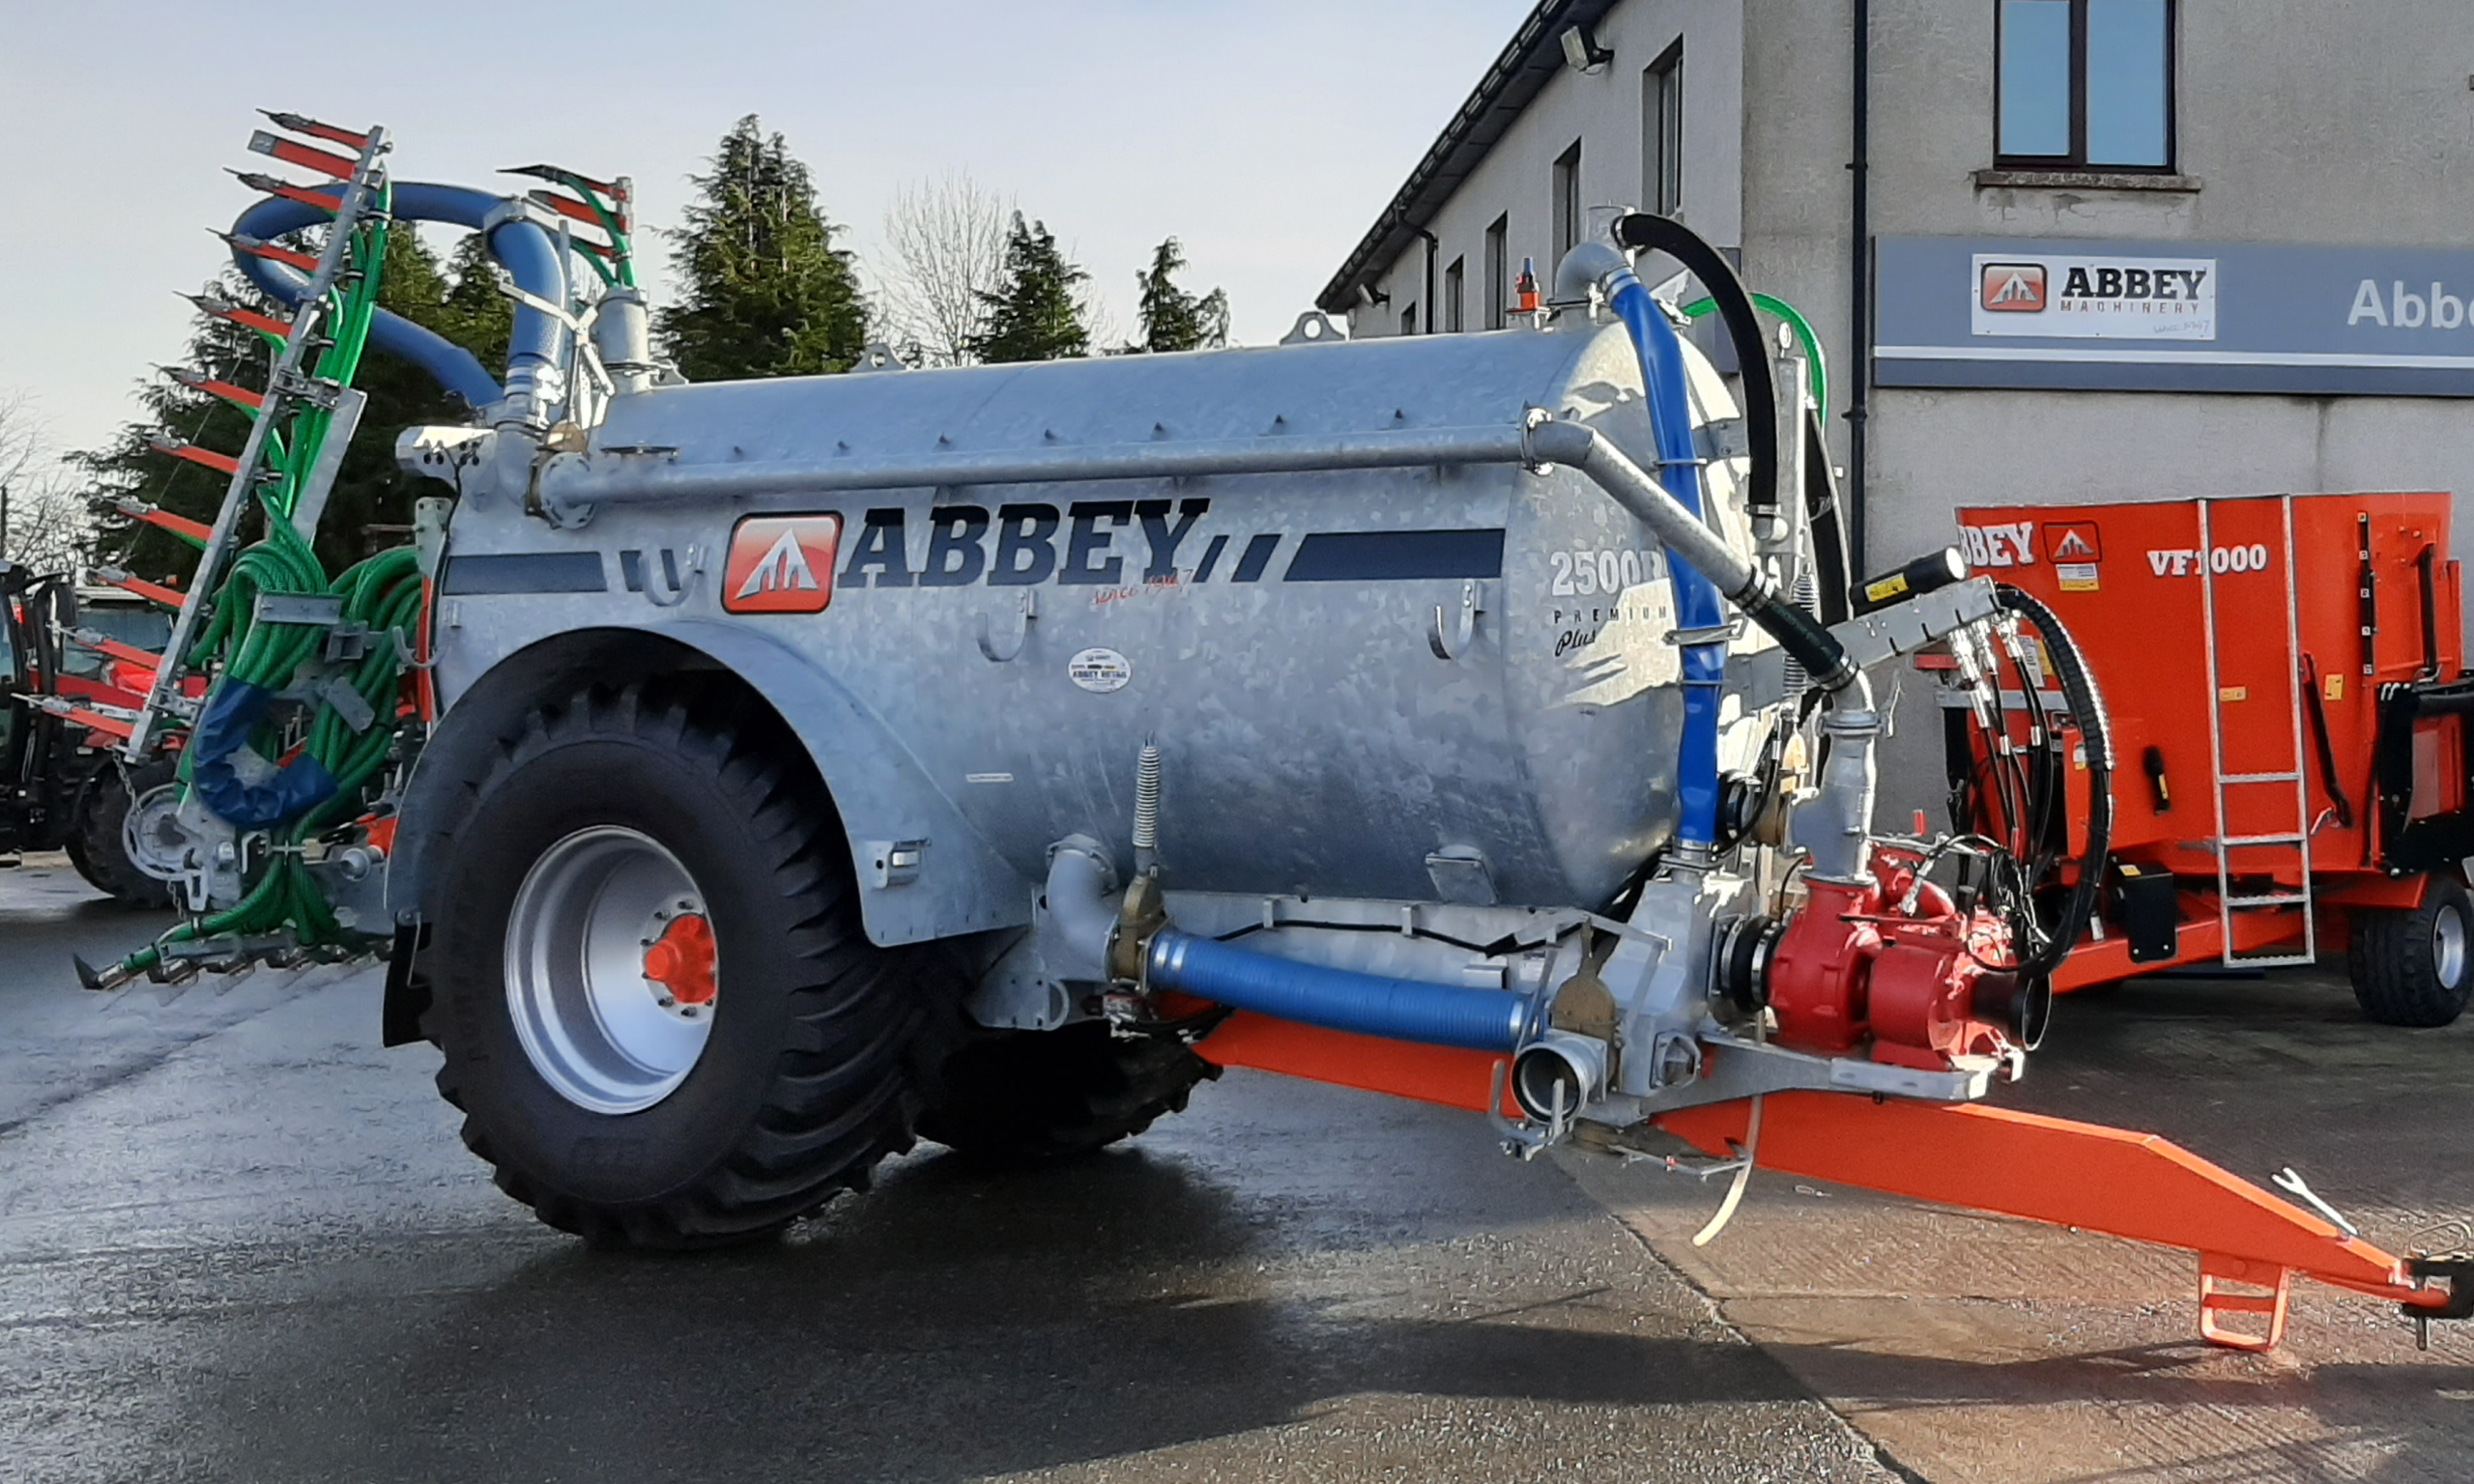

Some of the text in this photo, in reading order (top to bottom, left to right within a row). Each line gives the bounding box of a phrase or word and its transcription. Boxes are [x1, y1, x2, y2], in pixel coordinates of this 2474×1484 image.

[2061, 267, 2207, 300] ABBEY
[2059, 300, 2200, 314] MACHINERY
[836, 498, 1210, 588] ABBEY
[1957, 522, 2034, 567] BBEY
[2146, 544, 2267, 577] VF1000
[1553, 606, 1667, 624] PREMIUM
